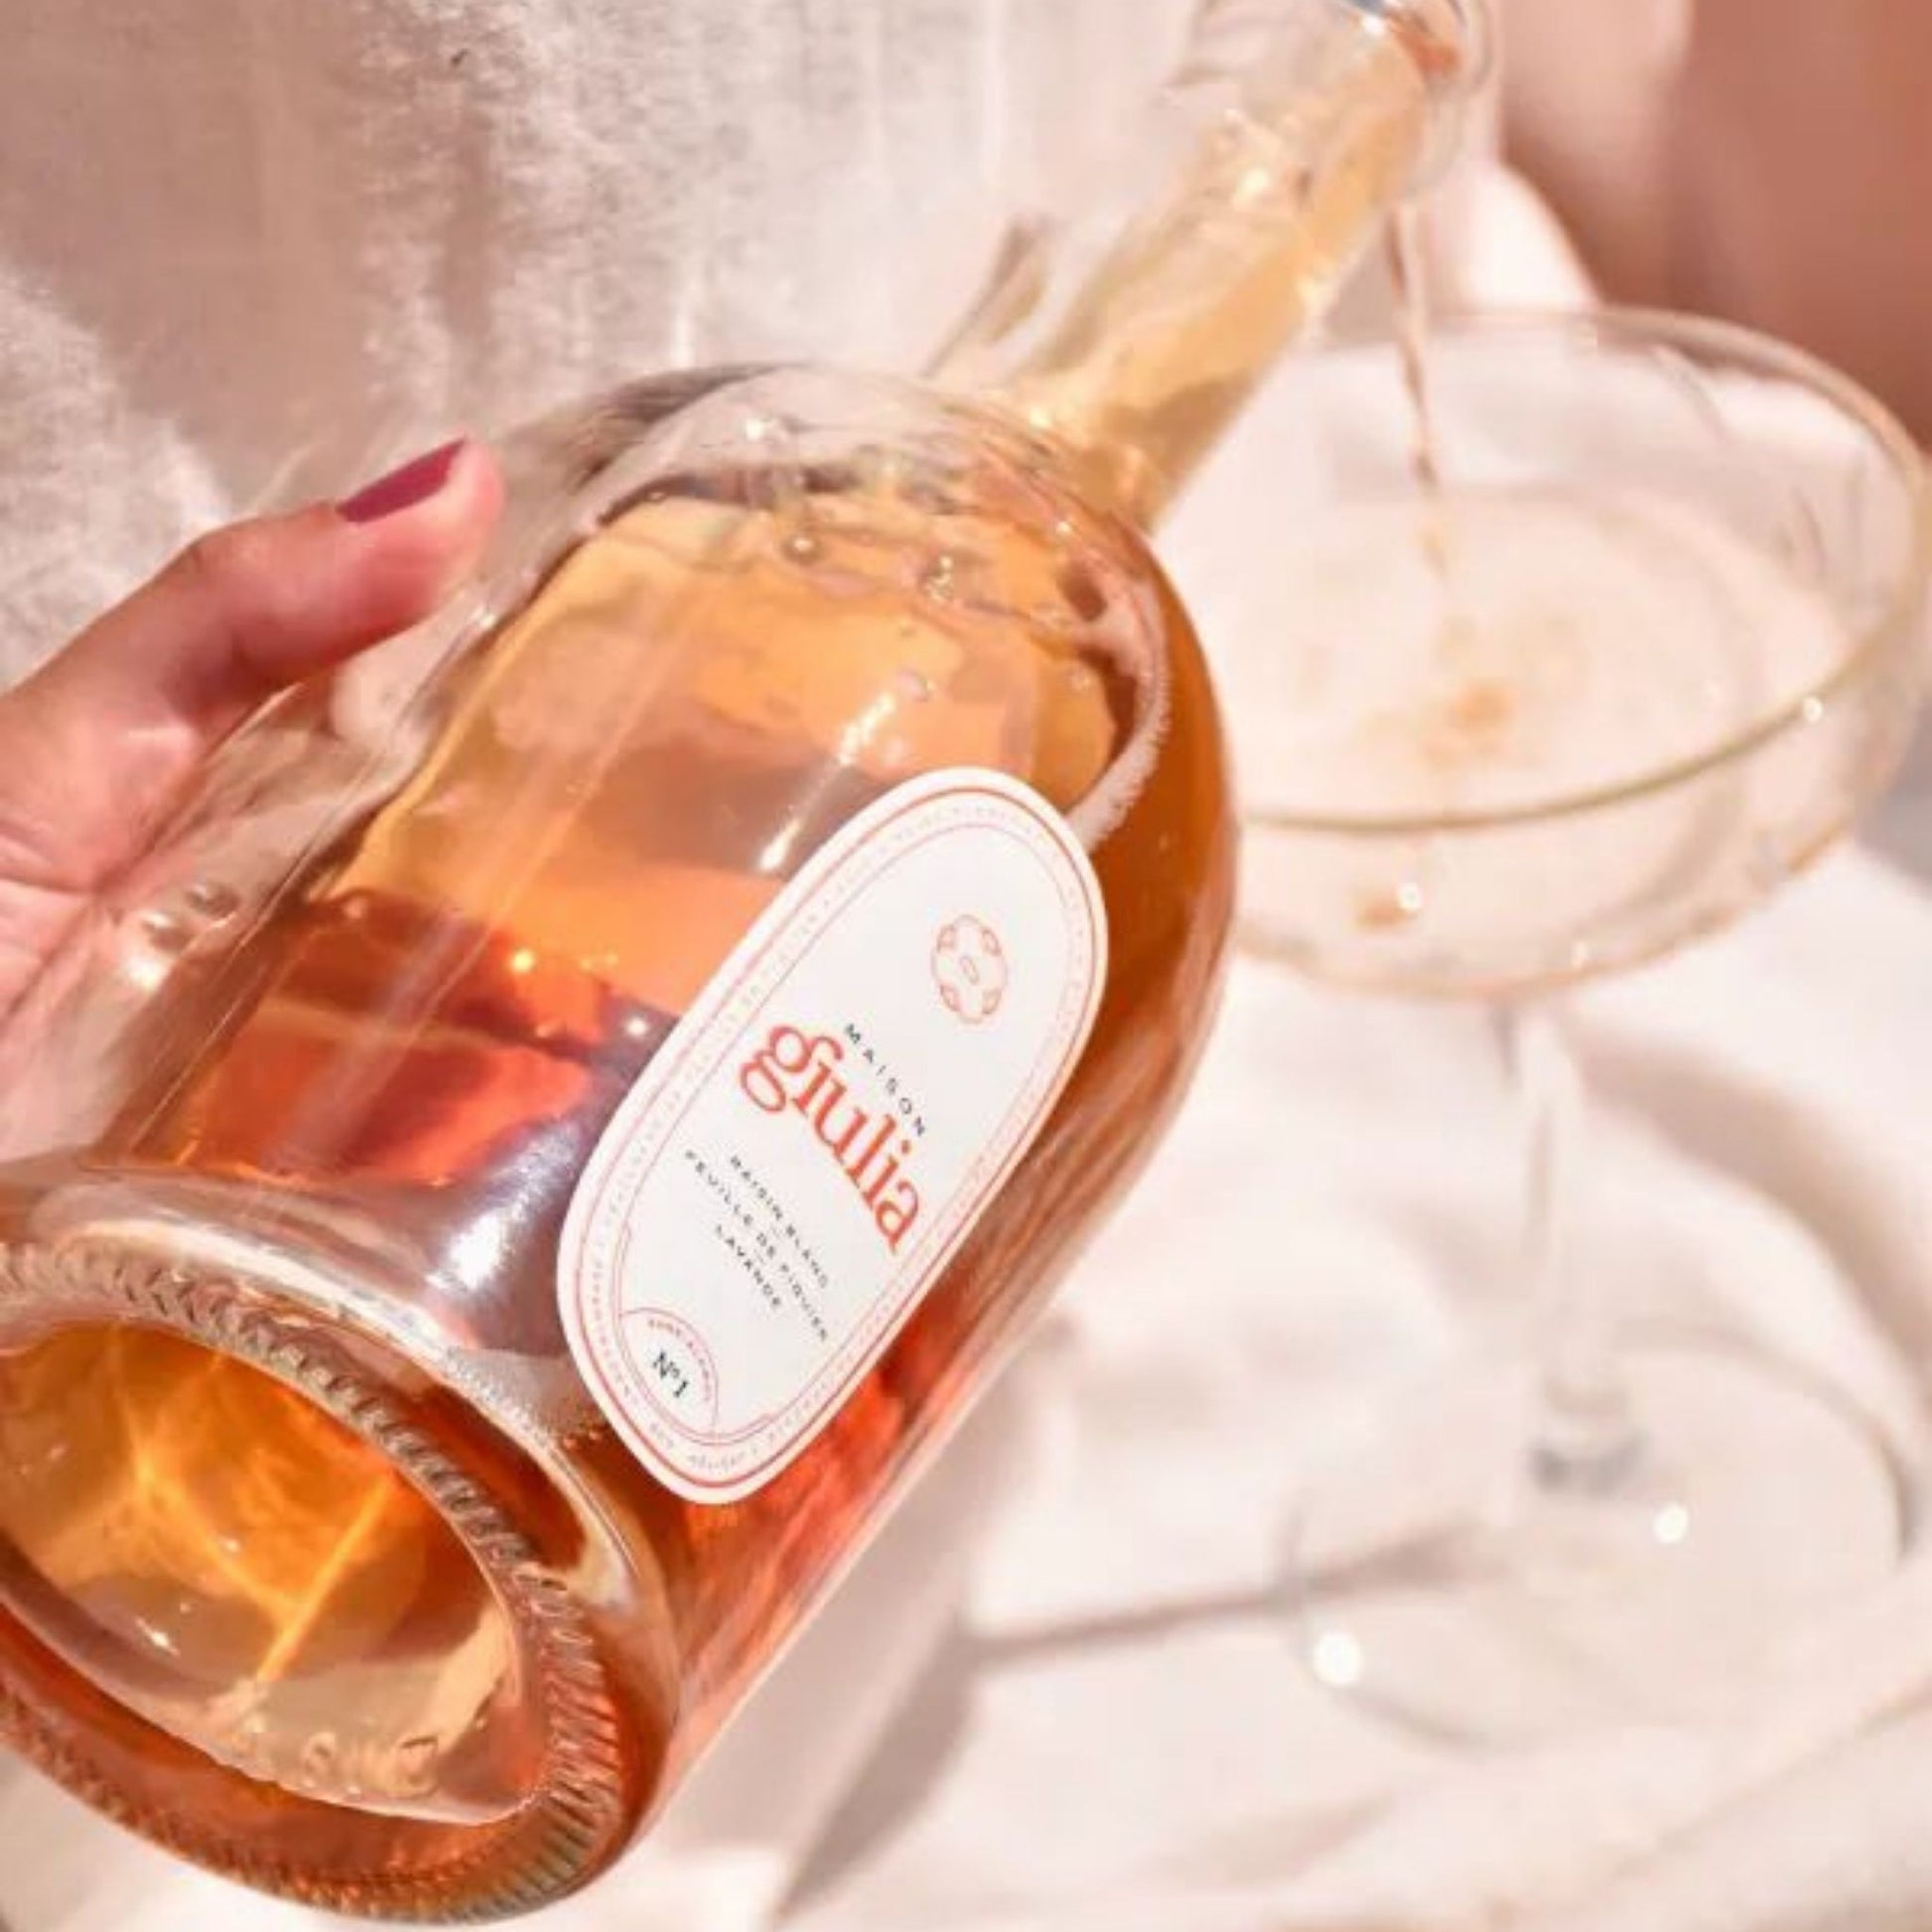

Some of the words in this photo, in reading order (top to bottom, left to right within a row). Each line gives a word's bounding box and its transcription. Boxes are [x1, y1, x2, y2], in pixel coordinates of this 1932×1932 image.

[846, 1024, 924, 1136] MAISON
[730, 1155, 783, 1221] RAISIN
[741, 1025, 919, 1256] giulia
[685, 1149, 754, 1227] FEUILLE
[756, 1232, 776, 1260] DE
[715, 1224, 781, 1308] LAVANDE
